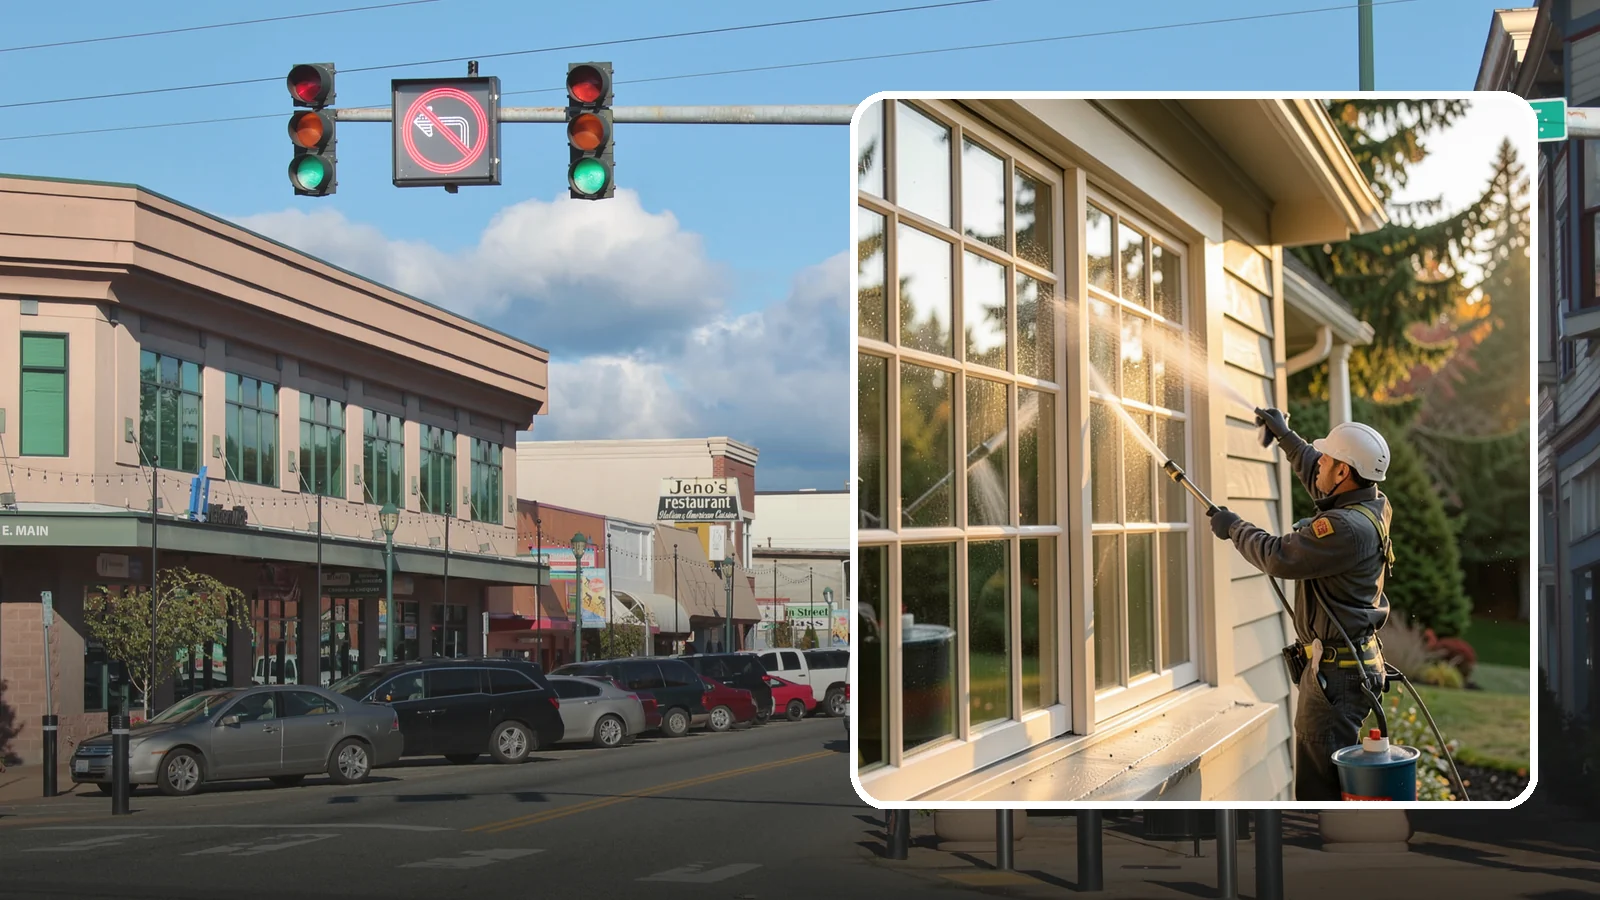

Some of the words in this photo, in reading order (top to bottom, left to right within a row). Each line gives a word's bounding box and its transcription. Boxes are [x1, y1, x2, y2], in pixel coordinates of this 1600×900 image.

[669, 480, 727, 494] Jeno's
[665, 496, 731, 508] restaurant
[658, 510, 681, 519] Italian
[686, 510, 714, 519] American
[715, 510, 737, 519] Cuisine
[2, 525, 13, 536] E.
[15, 525, 49, 536] MAIN
[797, 607, 828, 617] Street
[791, 619, 824, 627] lass
